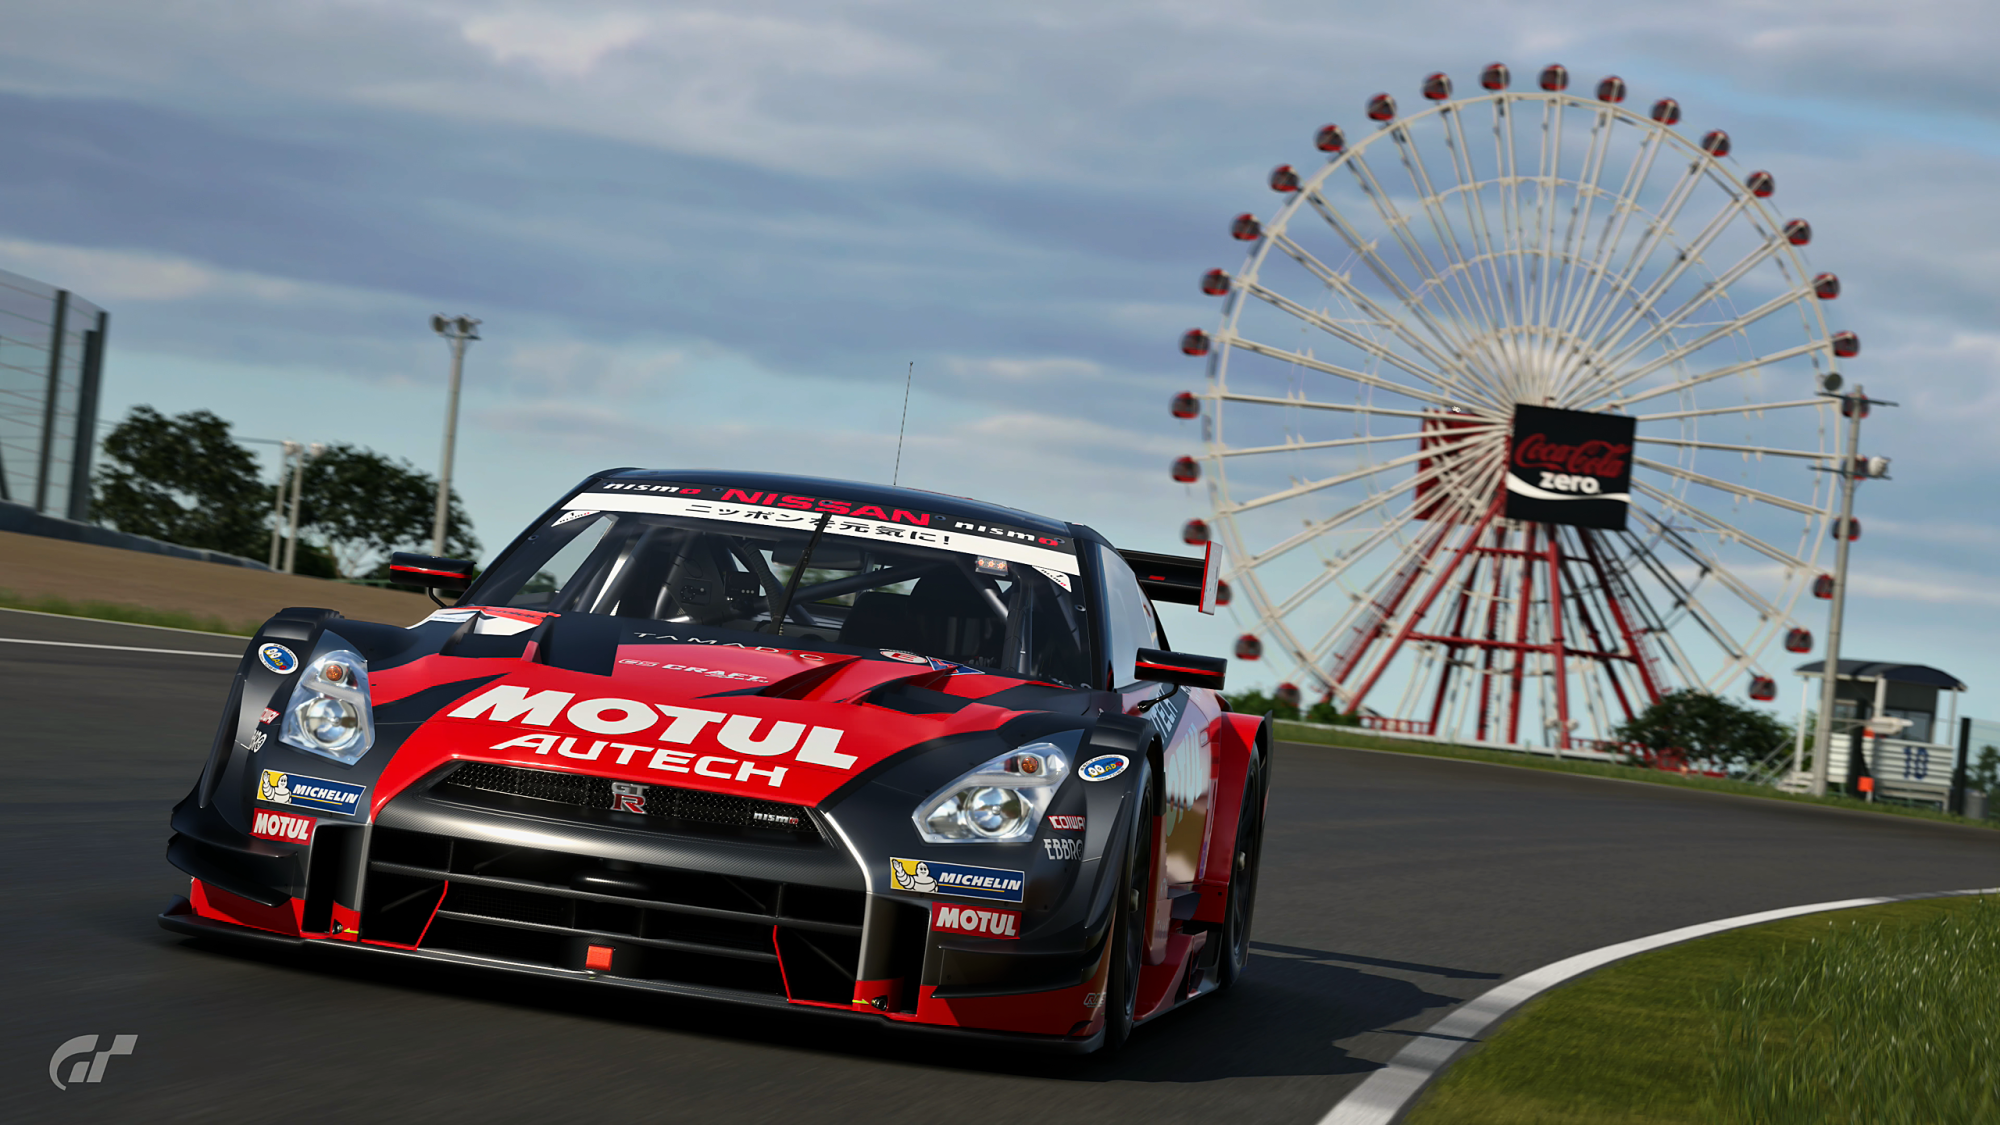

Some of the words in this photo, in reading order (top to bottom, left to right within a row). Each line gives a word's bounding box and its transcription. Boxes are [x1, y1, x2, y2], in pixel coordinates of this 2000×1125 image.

[603, 483, 701, 495] nismo
[1539, 471, 1600, 494] zero
[720, 488, 930, 526] NISSAN
[954, 521, 1059, 547] nismo
[634, 632, 824, 661] TAMADIC
[446, 684, 858, 770] MOTUL
[489, 733, 788, 787] AUTECH
[293, 783, 359, 804] MICHELIN
[253, 813, 310, 840] MOTUL
[753, 812, 799, 825] nismo
[938, 872, 1022, 891] MICHELIN
[936, 907, 1016, 937] MOTUL
